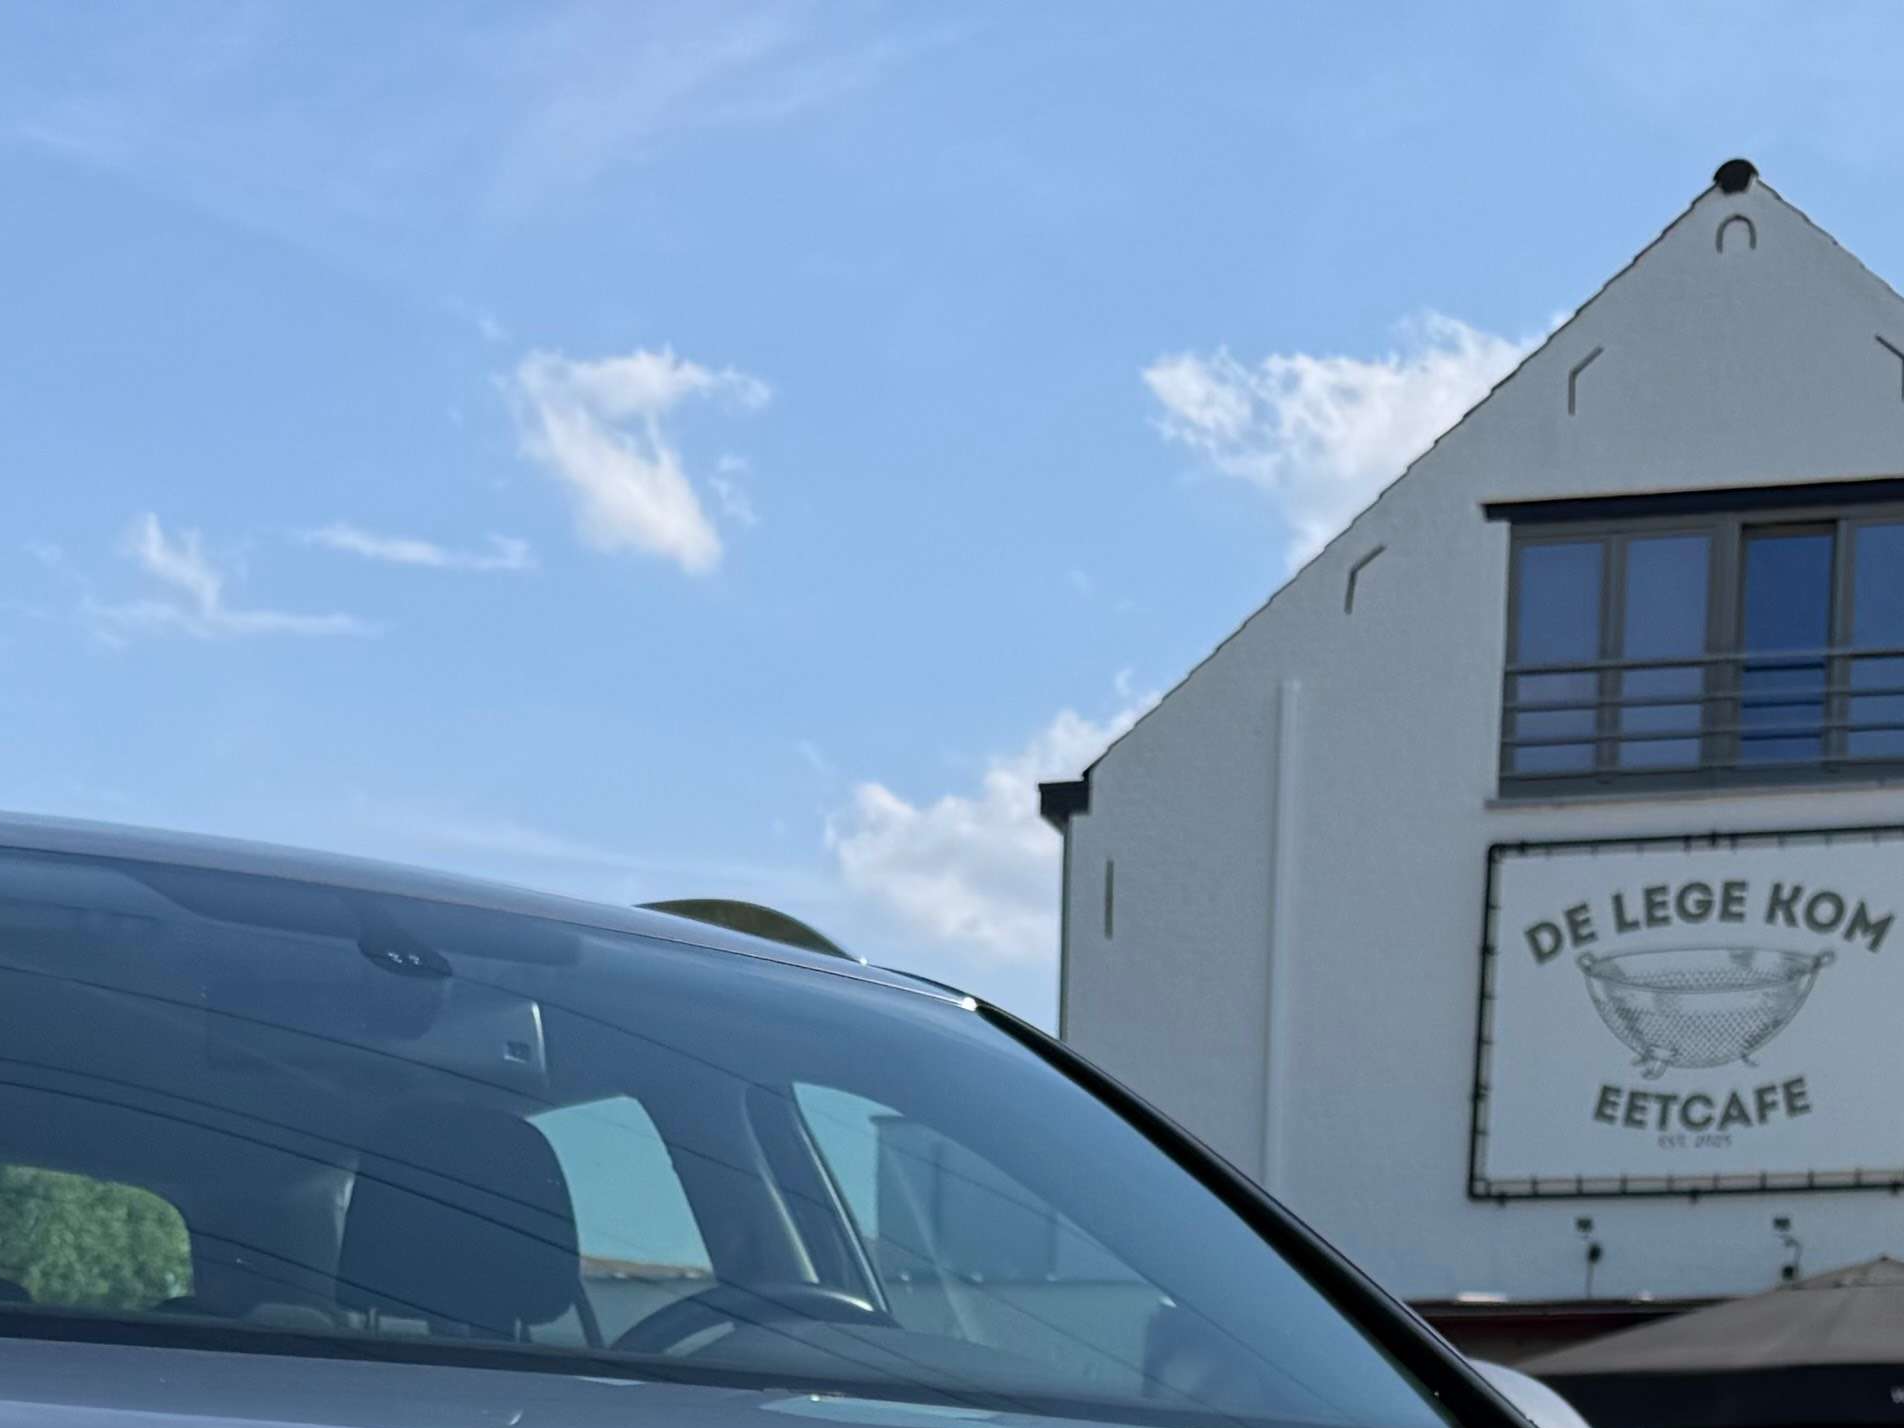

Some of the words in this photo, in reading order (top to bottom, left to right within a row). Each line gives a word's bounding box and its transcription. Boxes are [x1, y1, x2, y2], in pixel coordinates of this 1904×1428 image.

[1523, 903, 1599, 965] DE
[1611, 880, 1750, 934] LEGE
[1764, 882, 1895, 954] KOM
[1593, 1077, 1813, 1133] EETCAFE
